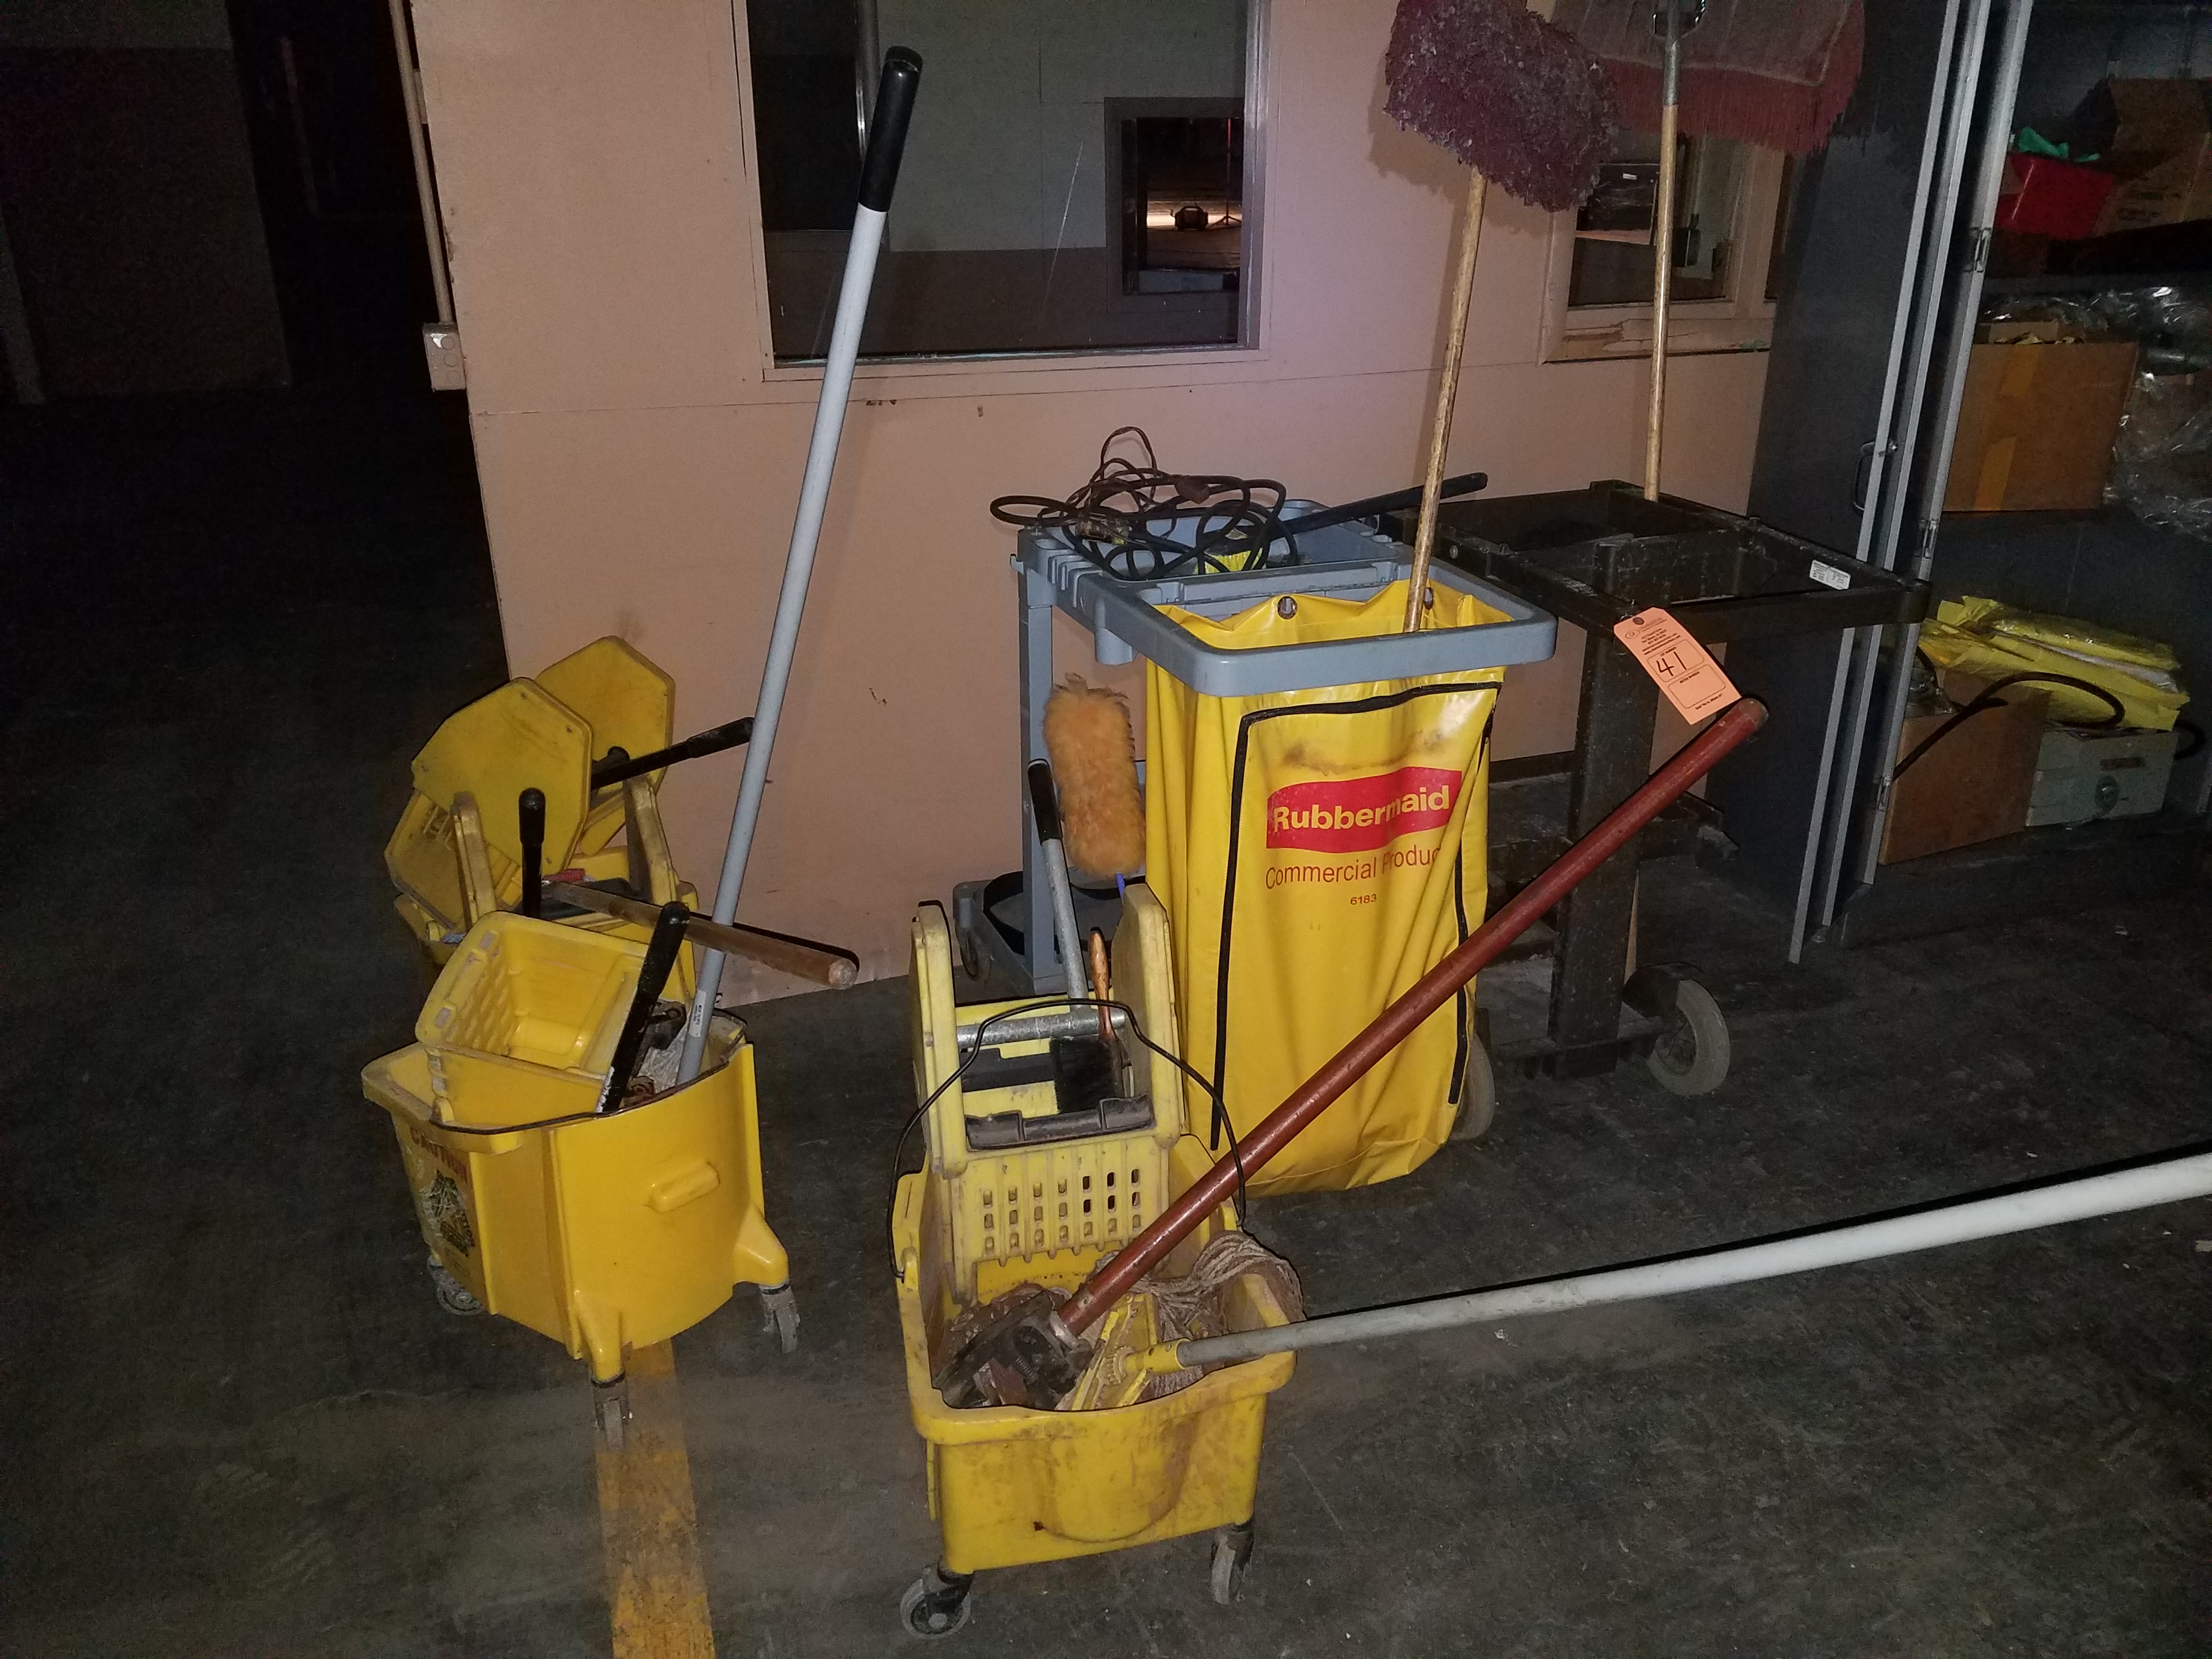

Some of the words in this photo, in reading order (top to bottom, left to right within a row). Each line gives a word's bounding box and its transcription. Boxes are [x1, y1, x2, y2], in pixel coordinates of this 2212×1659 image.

[1656, 651, 1687, 676] 41
[1273, 785, 1450, 833] Rubbermaid
[1266, 857, 1376, 889] Commercial
[1350, 893, 1378, 906] 6183
